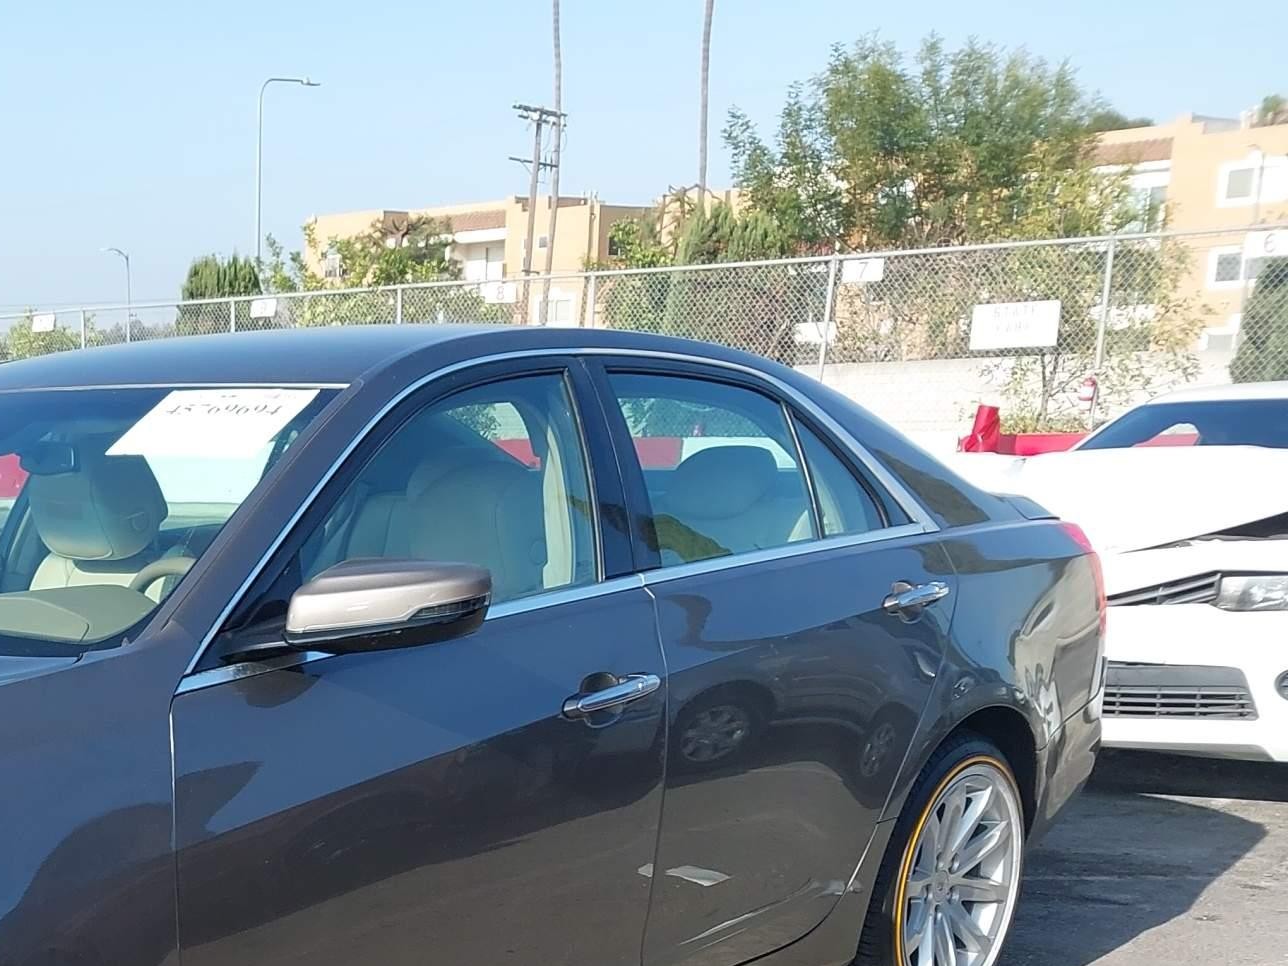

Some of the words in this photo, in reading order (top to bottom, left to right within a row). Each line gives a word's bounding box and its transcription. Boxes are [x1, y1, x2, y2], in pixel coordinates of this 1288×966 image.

[1264, 232, 1278, 254] 6
[858, 261, 870, 280] 7
[495, 285, 505, 301] 8
